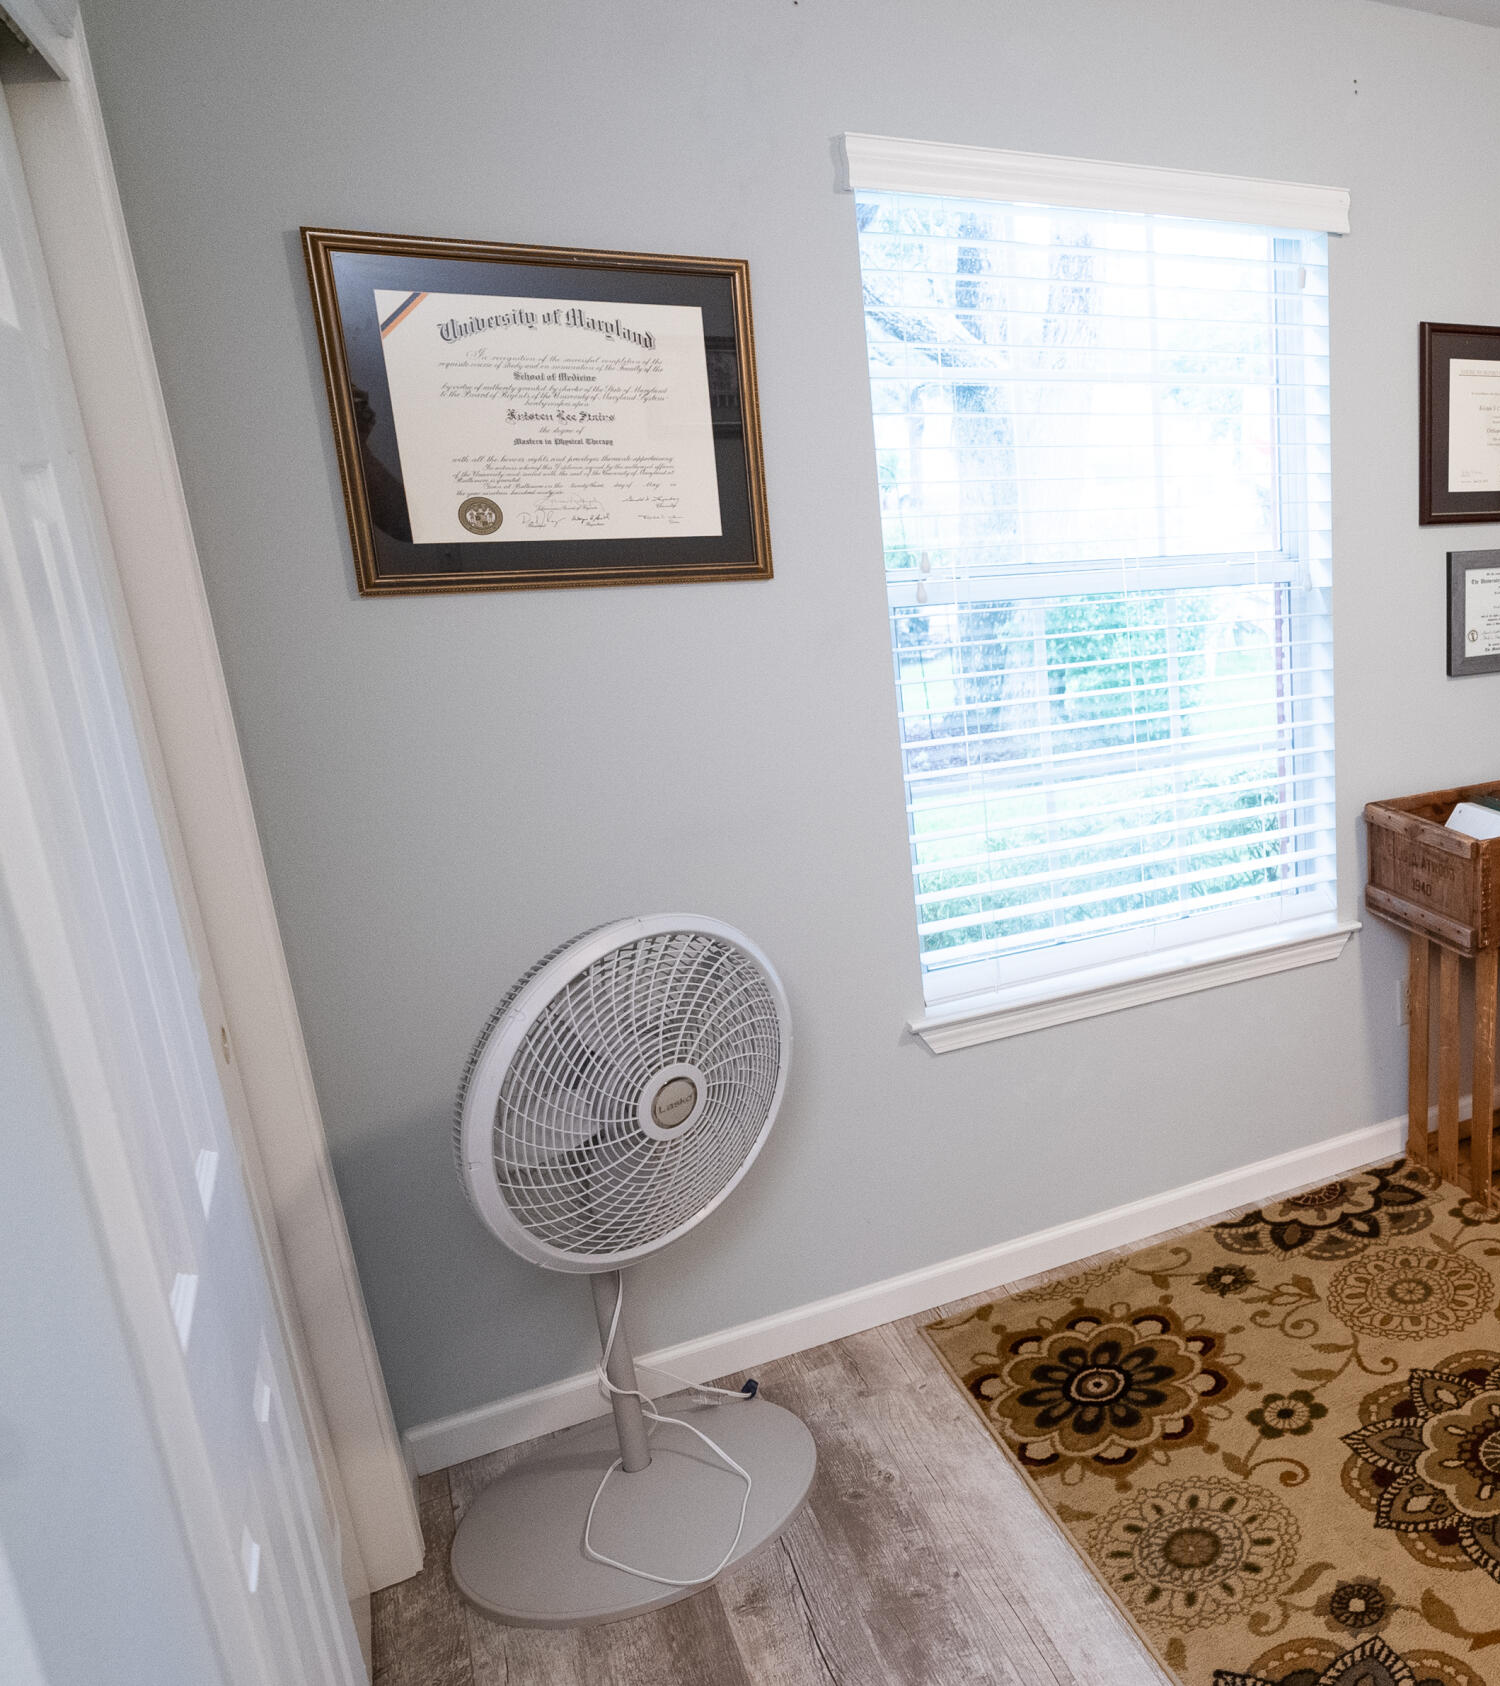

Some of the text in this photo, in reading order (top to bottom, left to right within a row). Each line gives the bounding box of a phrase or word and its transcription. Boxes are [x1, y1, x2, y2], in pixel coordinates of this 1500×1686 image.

[437, 308, 656, 350] University of Maryland
[513, 372, 597, 382] School of Medicine
[506, 409, 615, 425] Kristen Lee Stairs
[585, 438, 613, 446] Therapy
[1412, 878, 1432, 896] 1940
[658, 1094, 693, 1114] Lasko
